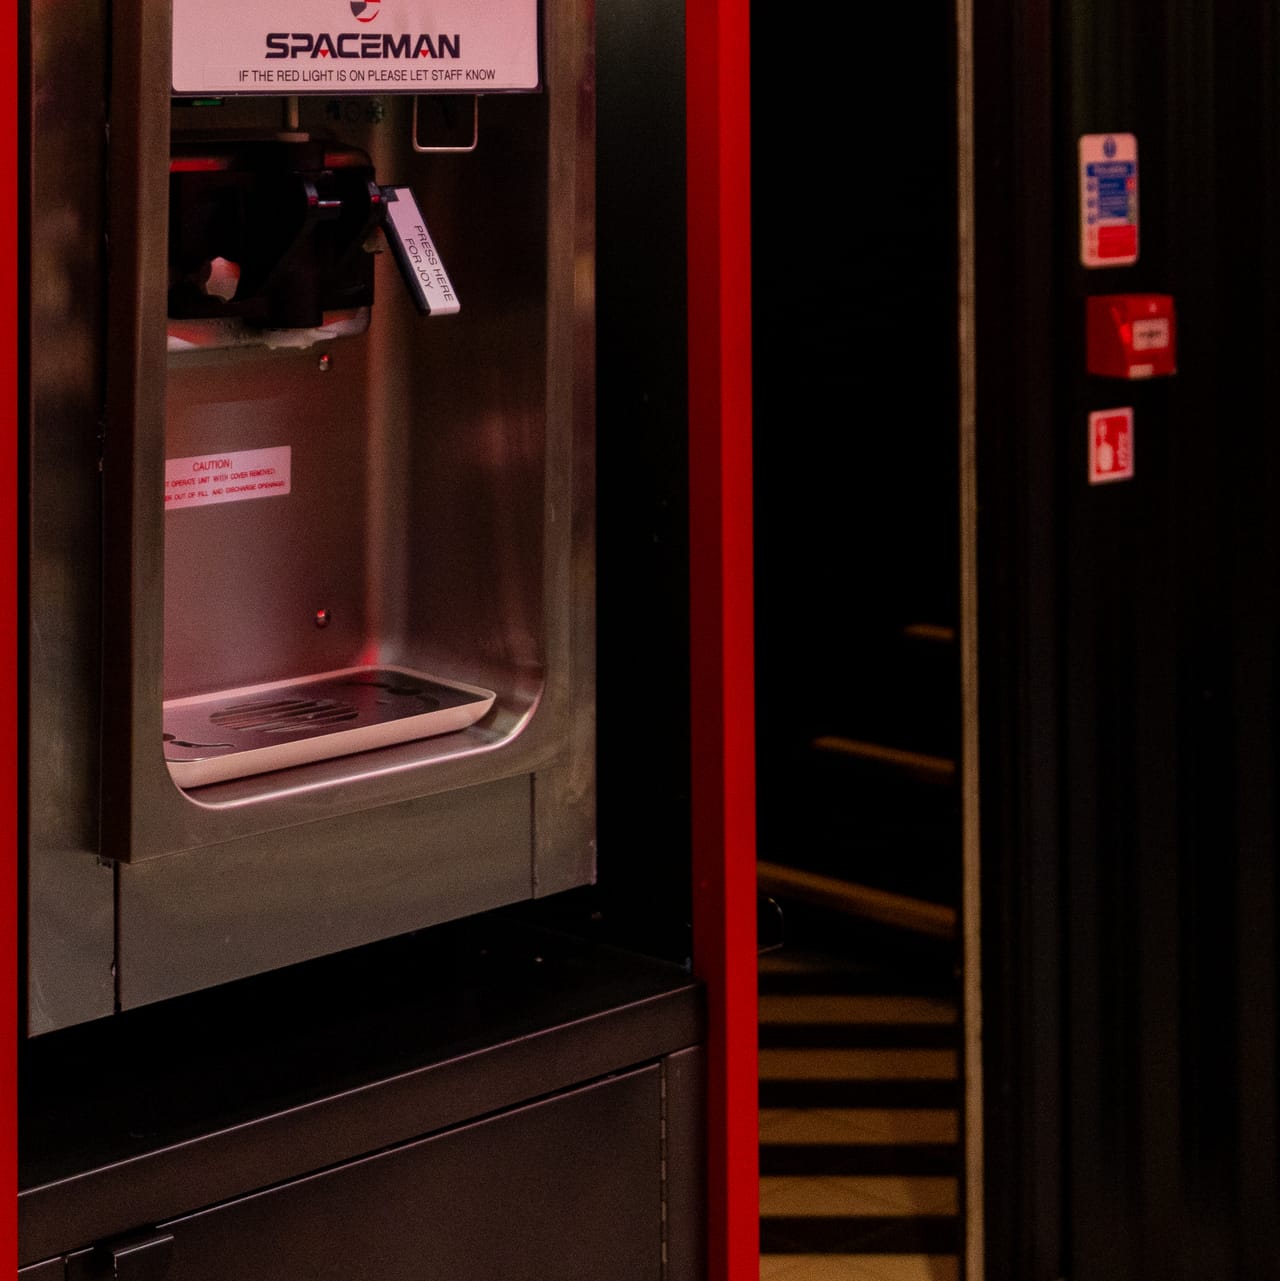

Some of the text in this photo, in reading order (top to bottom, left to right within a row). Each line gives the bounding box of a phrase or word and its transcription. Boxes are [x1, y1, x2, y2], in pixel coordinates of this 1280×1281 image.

[265, 33, 460, 59] SPACEMAN
[239, 68, 496, 82] IF THE RED LIGHT IS ON PLEASE LET STAFF KNOW
[404, 237, 433, 289] FOR JOY
[414, 224, 454, 302] PRESS HERE
